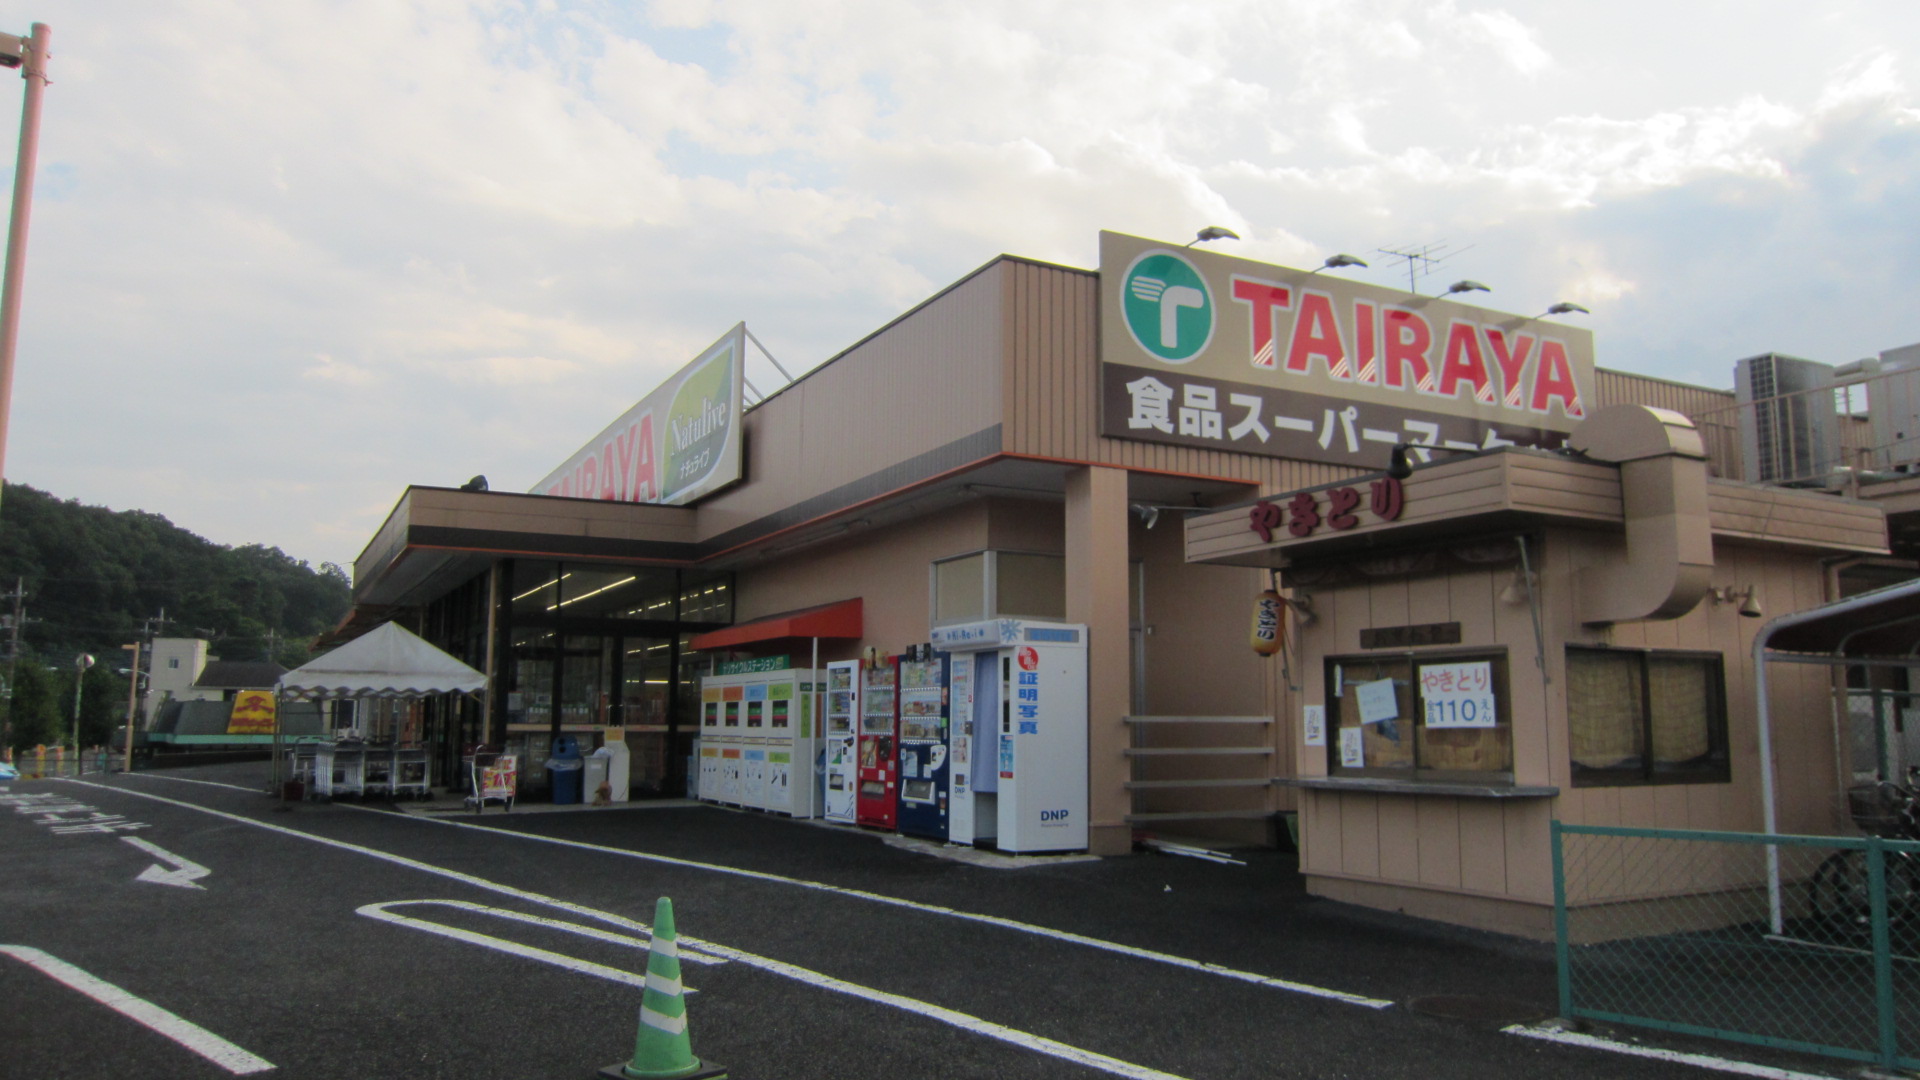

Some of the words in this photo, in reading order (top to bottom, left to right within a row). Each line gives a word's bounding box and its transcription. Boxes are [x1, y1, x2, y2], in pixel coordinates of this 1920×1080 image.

[1232, 277, 1585, 418] TAIRAYA
[671, 397, 726, 456] Natulive
[1250, 477, 1404, 543] やきとり
[1018, 671, 1038, 734] 証明写真
[1421, 667, 1488, 693] やきとり
[1436, 699, 1477, 722] 110
[1481, 698, 1492, 722] えん
[1041, 809, 1069, 821] DNP
